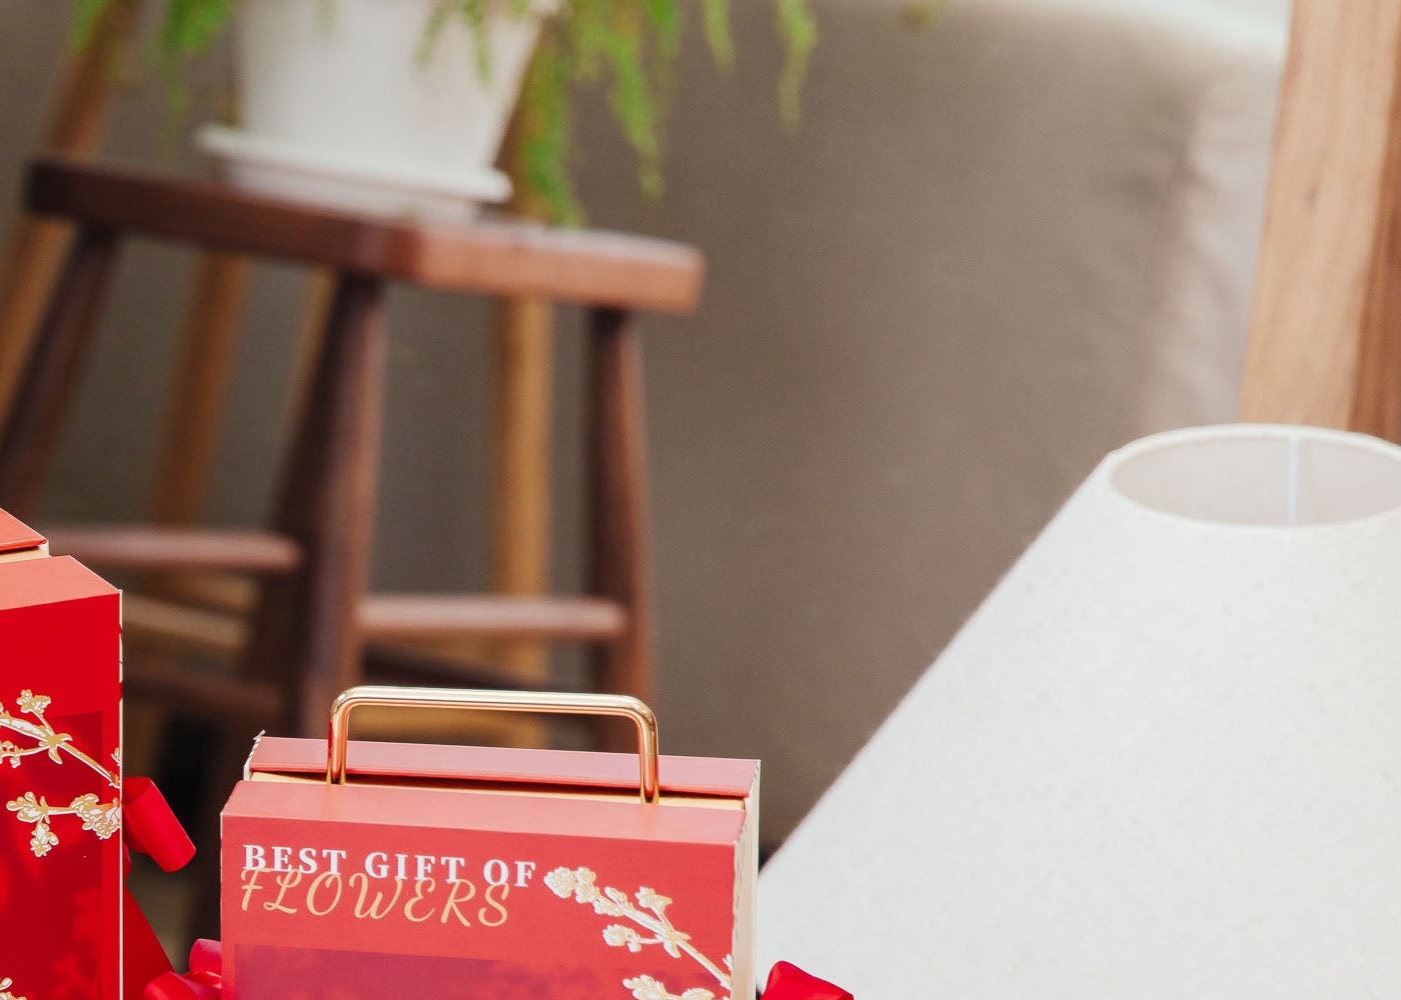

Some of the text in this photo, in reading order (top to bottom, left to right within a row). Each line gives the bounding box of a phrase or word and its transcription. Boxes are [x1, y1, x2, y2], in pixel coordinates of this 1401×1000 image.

[242, 844, 536, 888] BEST GIFT OF
[240, 867, 510, 927] FLOWERS
